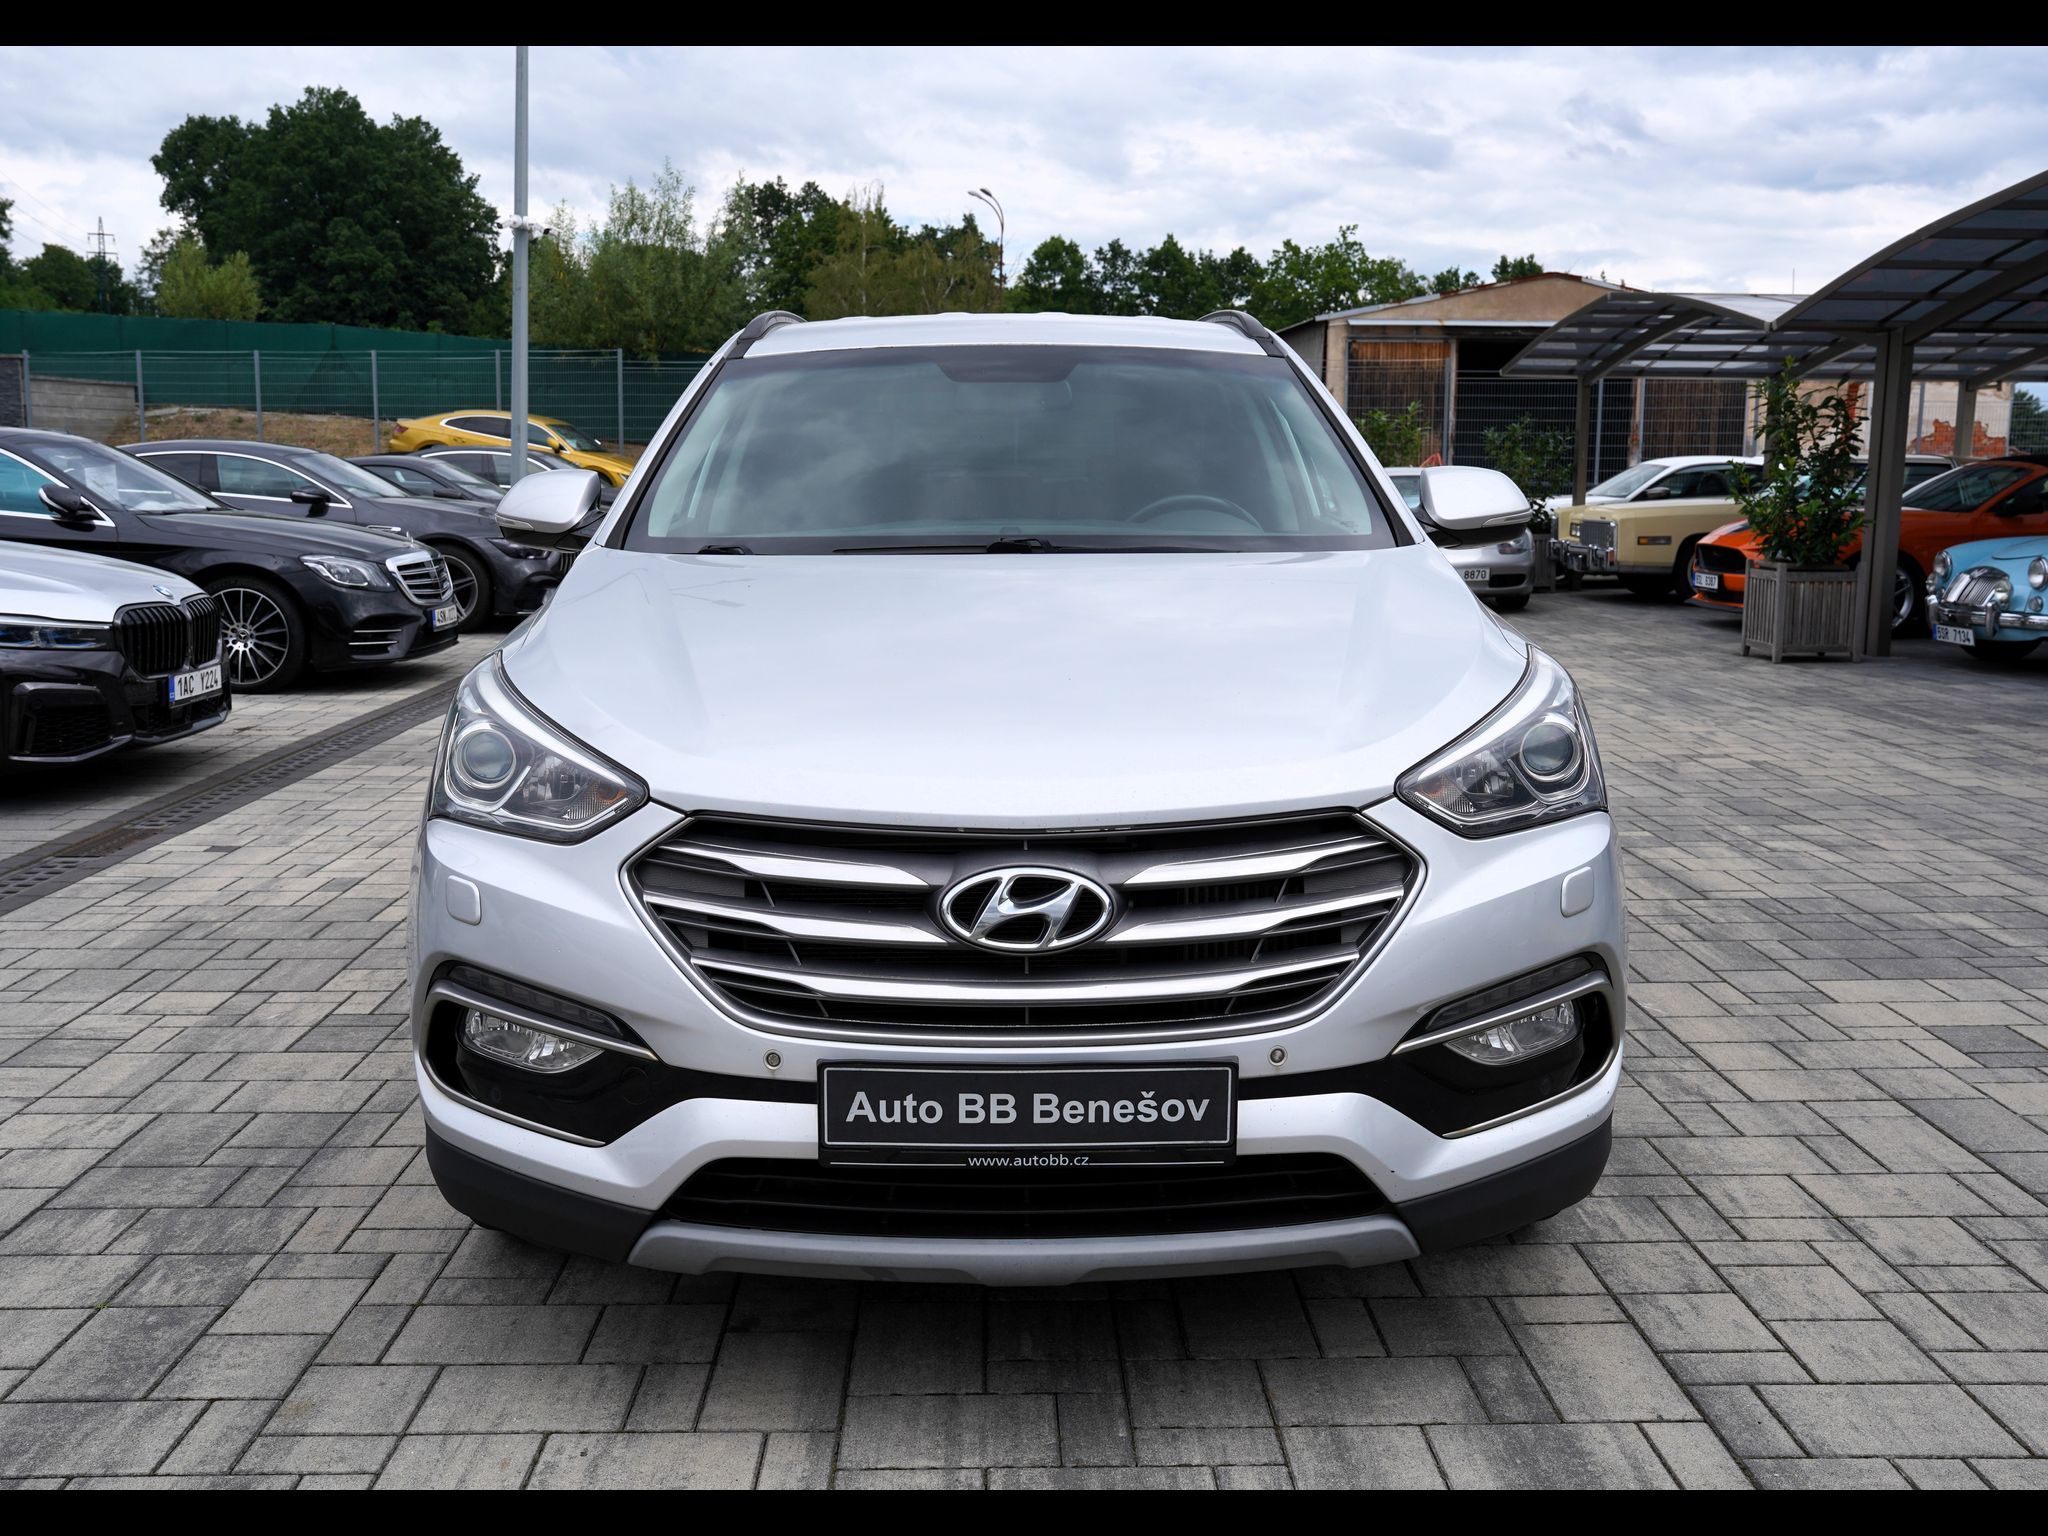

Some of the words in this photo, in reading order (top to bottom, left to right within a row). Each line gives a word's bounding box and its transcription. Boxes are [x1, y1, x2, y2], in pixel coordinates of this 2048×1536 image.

[1463, 569, 1487, 580] 8870
[1952, 628, 1971, 644] 7134
[177, 674, 195, 698] 1AC
[200, 668, 219, 692] Y224
[845, 1090, 944, 1125] Auto
[957, 1092, 1018, 1125] BB
[1032, 1090, 1211, 1125] Benešov
[967, 1153, 1090, 1167] www.autobb.cz
